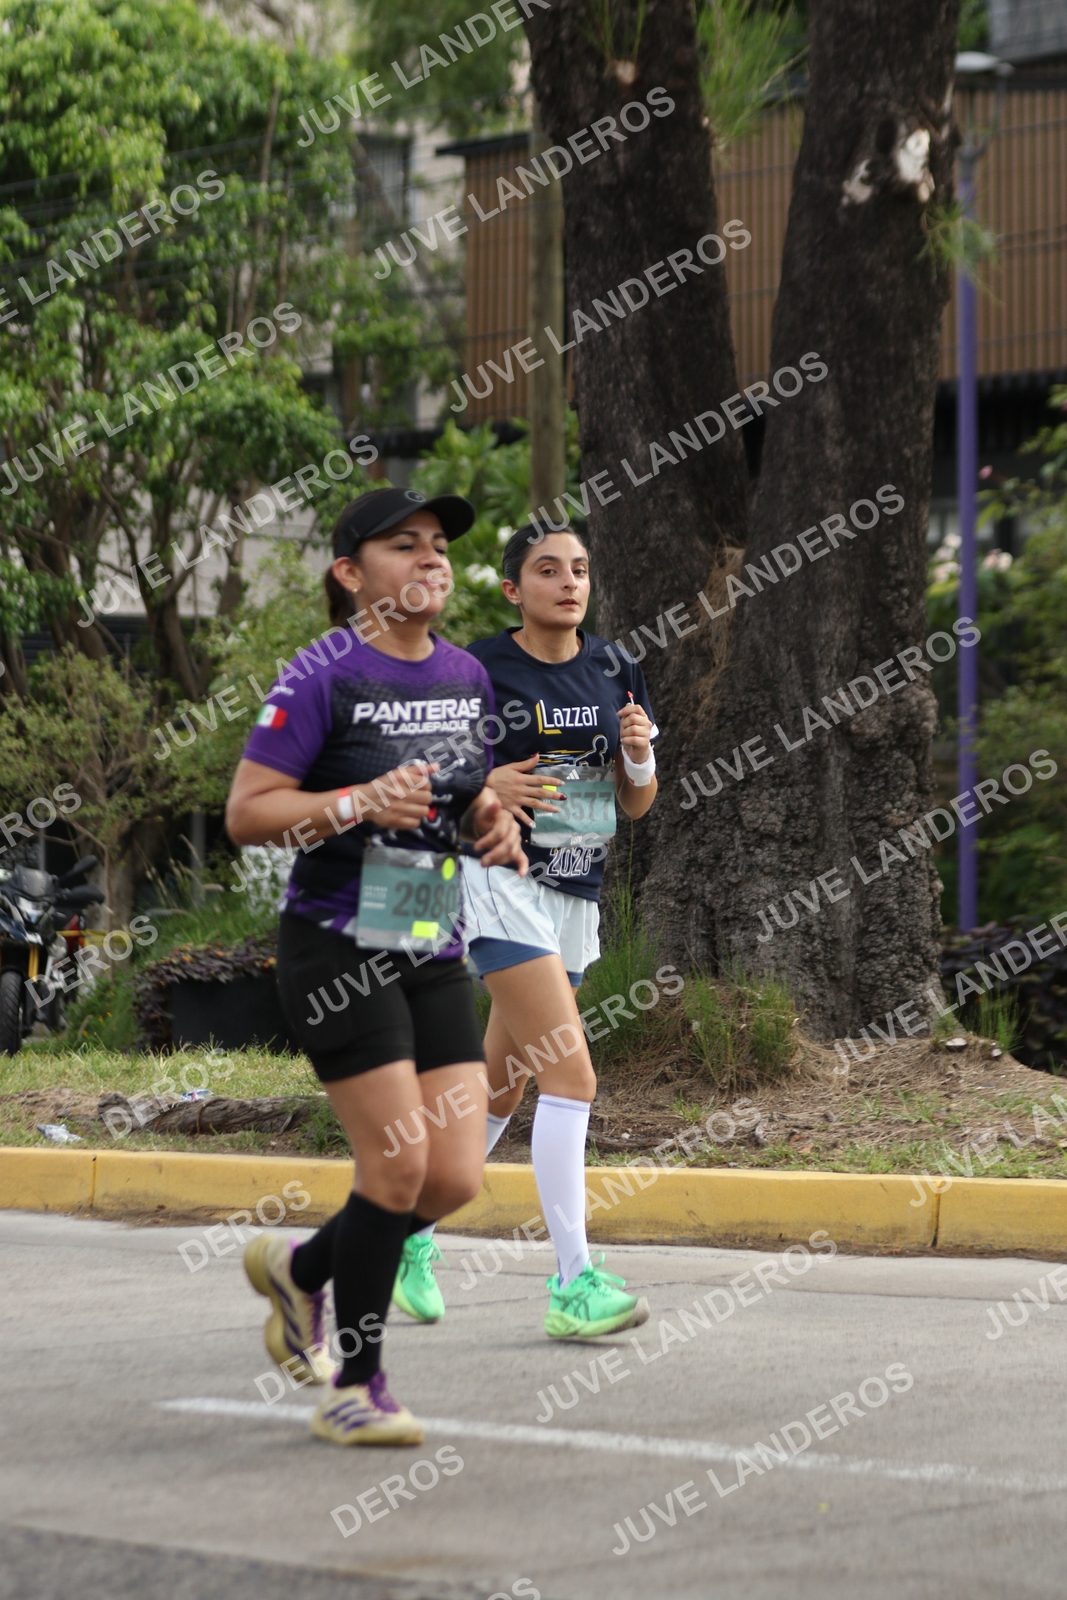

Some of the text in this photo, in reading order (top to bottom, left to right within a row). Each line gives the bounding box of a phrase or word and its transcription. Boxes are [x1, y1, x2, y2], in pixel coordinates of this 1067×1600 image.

[352, 698, 481, 724] PANTERAS
[537, 699, 600, 730] Lazzar
[380, 720, 469, 735] TLAQUEPAQUE
[546, 845, 597, 877] 2026
